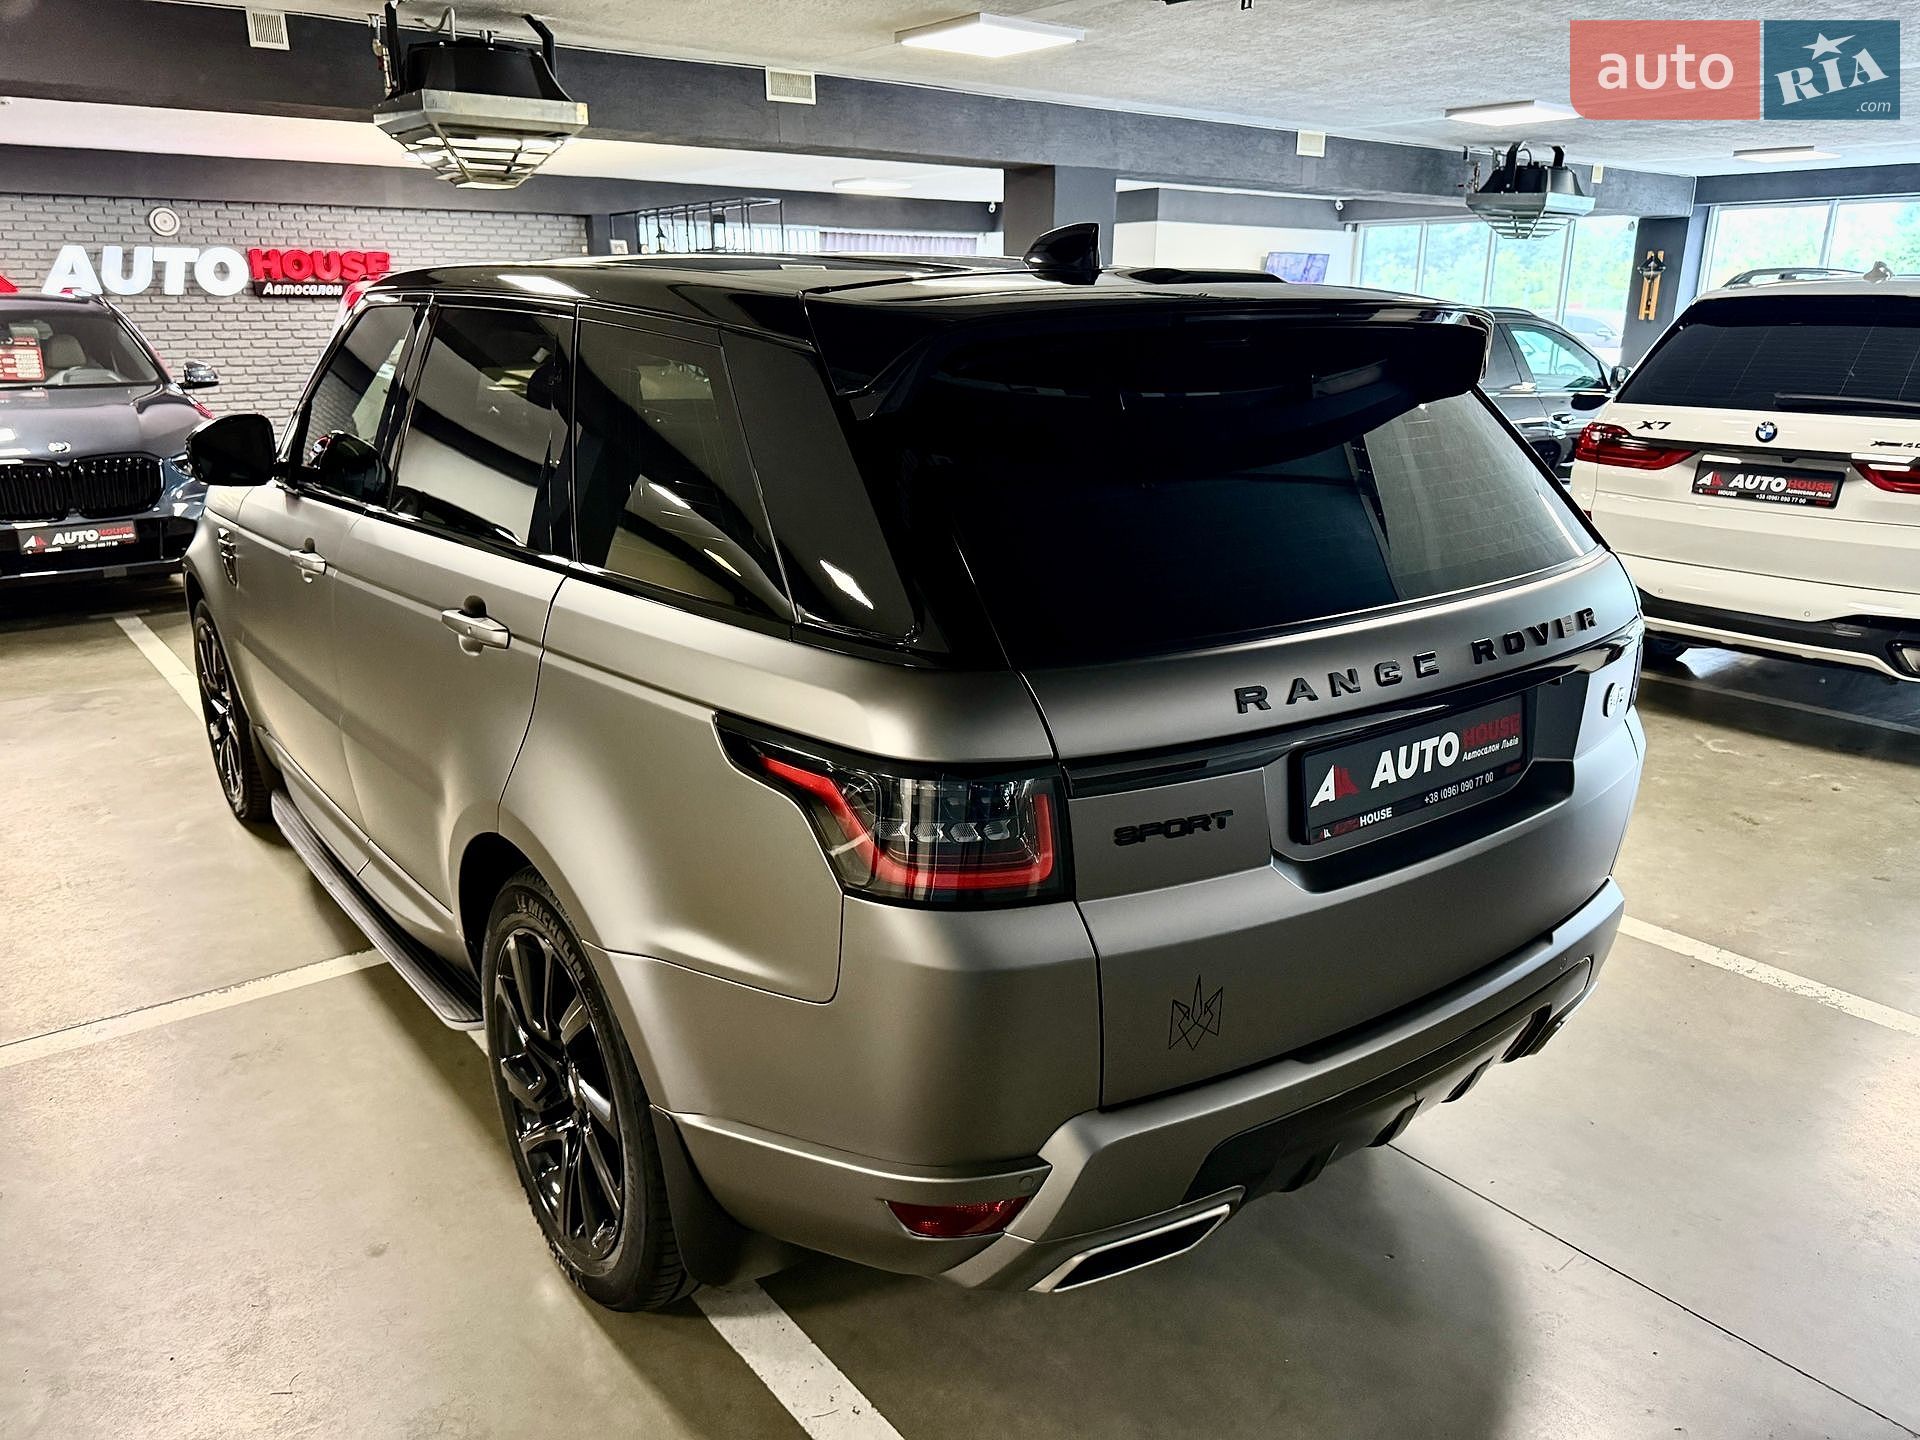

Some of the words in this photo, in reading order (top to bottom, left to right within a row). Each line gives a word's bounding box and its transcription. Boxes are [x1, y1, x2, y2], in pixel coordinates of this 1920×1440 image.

[41, 245, 250, 297] AUTO
[248, 248, 390, 282] HOUSE
[262, 282, 344, 296] Автосалон
[1636, 420, 1671, 430] X7
[1728, 473, 1787, 492] AUTO
[52, 530, 99, 545] AUTO
[1234, 650, 1440, 714] RANGE
[1471, 607, 1599, 665] ROVER
[1371, 731, 1460, 789] AUTO
[1462, 743, 1500, 762] Автосалон
[1424, 791, 1439, 804] +38
[1440, 784, 1459, 799] (096)
[1460, 779, 1474, 793] 090
[1474, 775, 1484, 787] 77
[1484, 771, 1494, 784] 00
[1114, 809, 1234, 847] SPORT
[1360, 807, 1392, 827] HOUSE
[527, 898, 586, 981] MICHELIN
